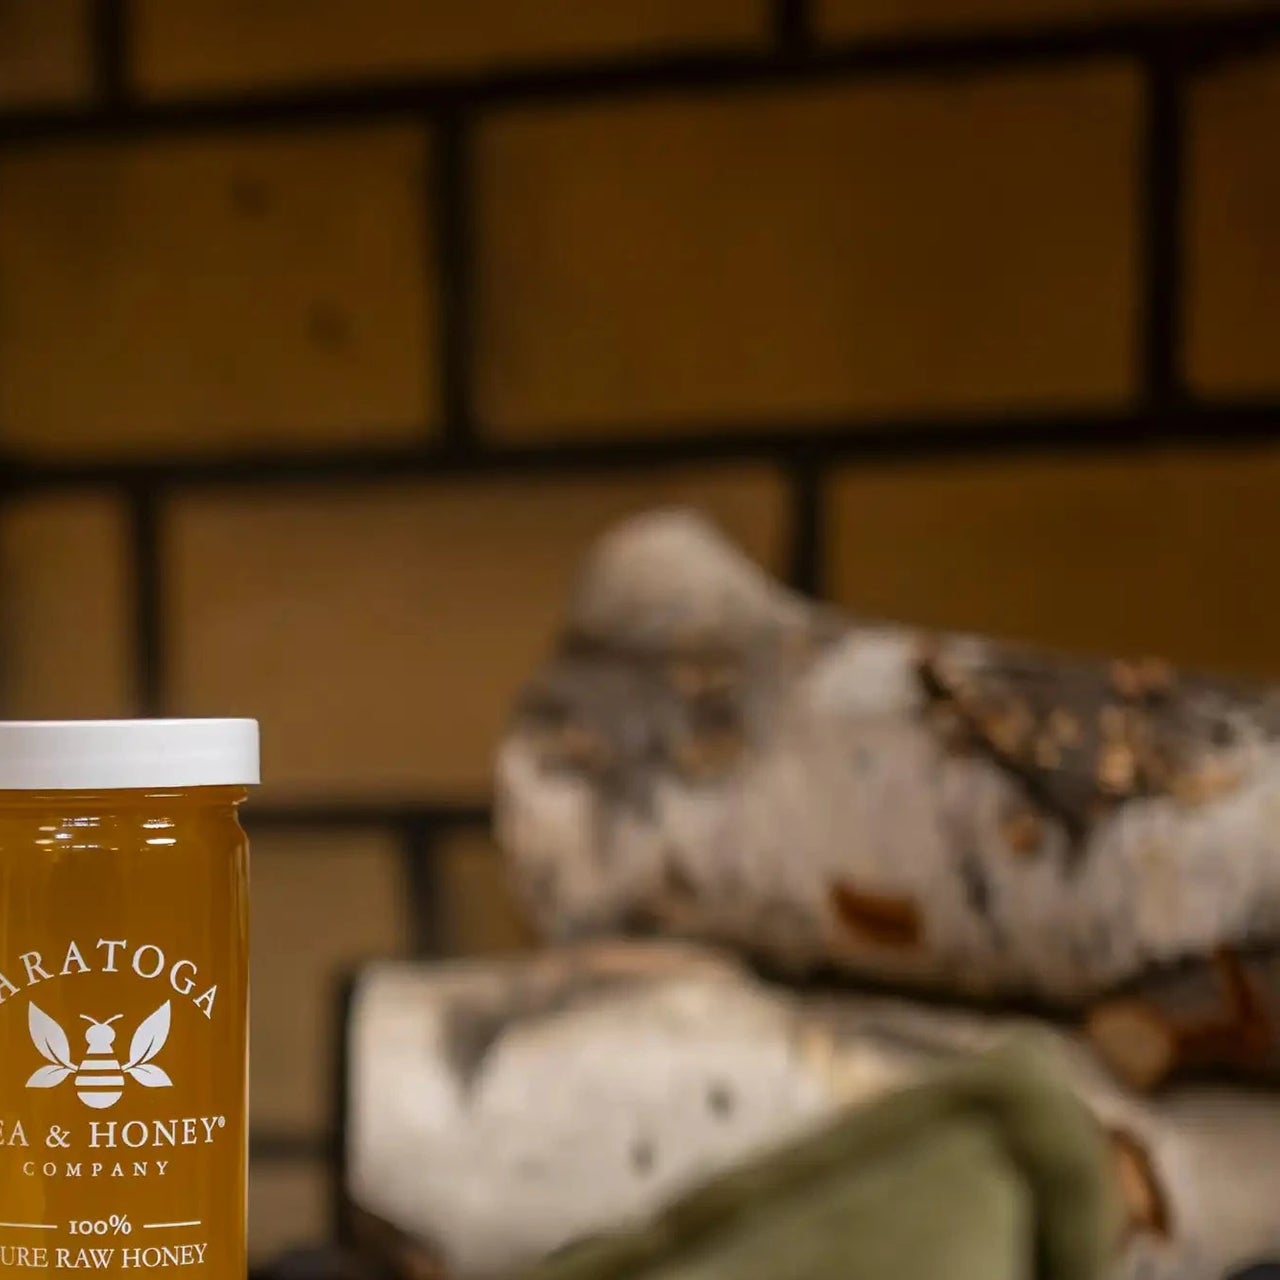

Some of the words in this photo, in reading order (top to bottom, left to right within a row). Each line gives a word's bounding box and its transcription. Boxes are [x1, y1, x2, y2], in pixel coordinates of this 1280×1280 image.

[46, 1125, 70, 1148] &
[23, 1161, 168, 1176] COMPANY
[70, 1215, 131, 1235] 100%
[56, 1248, 114, 1268] RAW
[122, 1243, 207, 1268] HONEY
